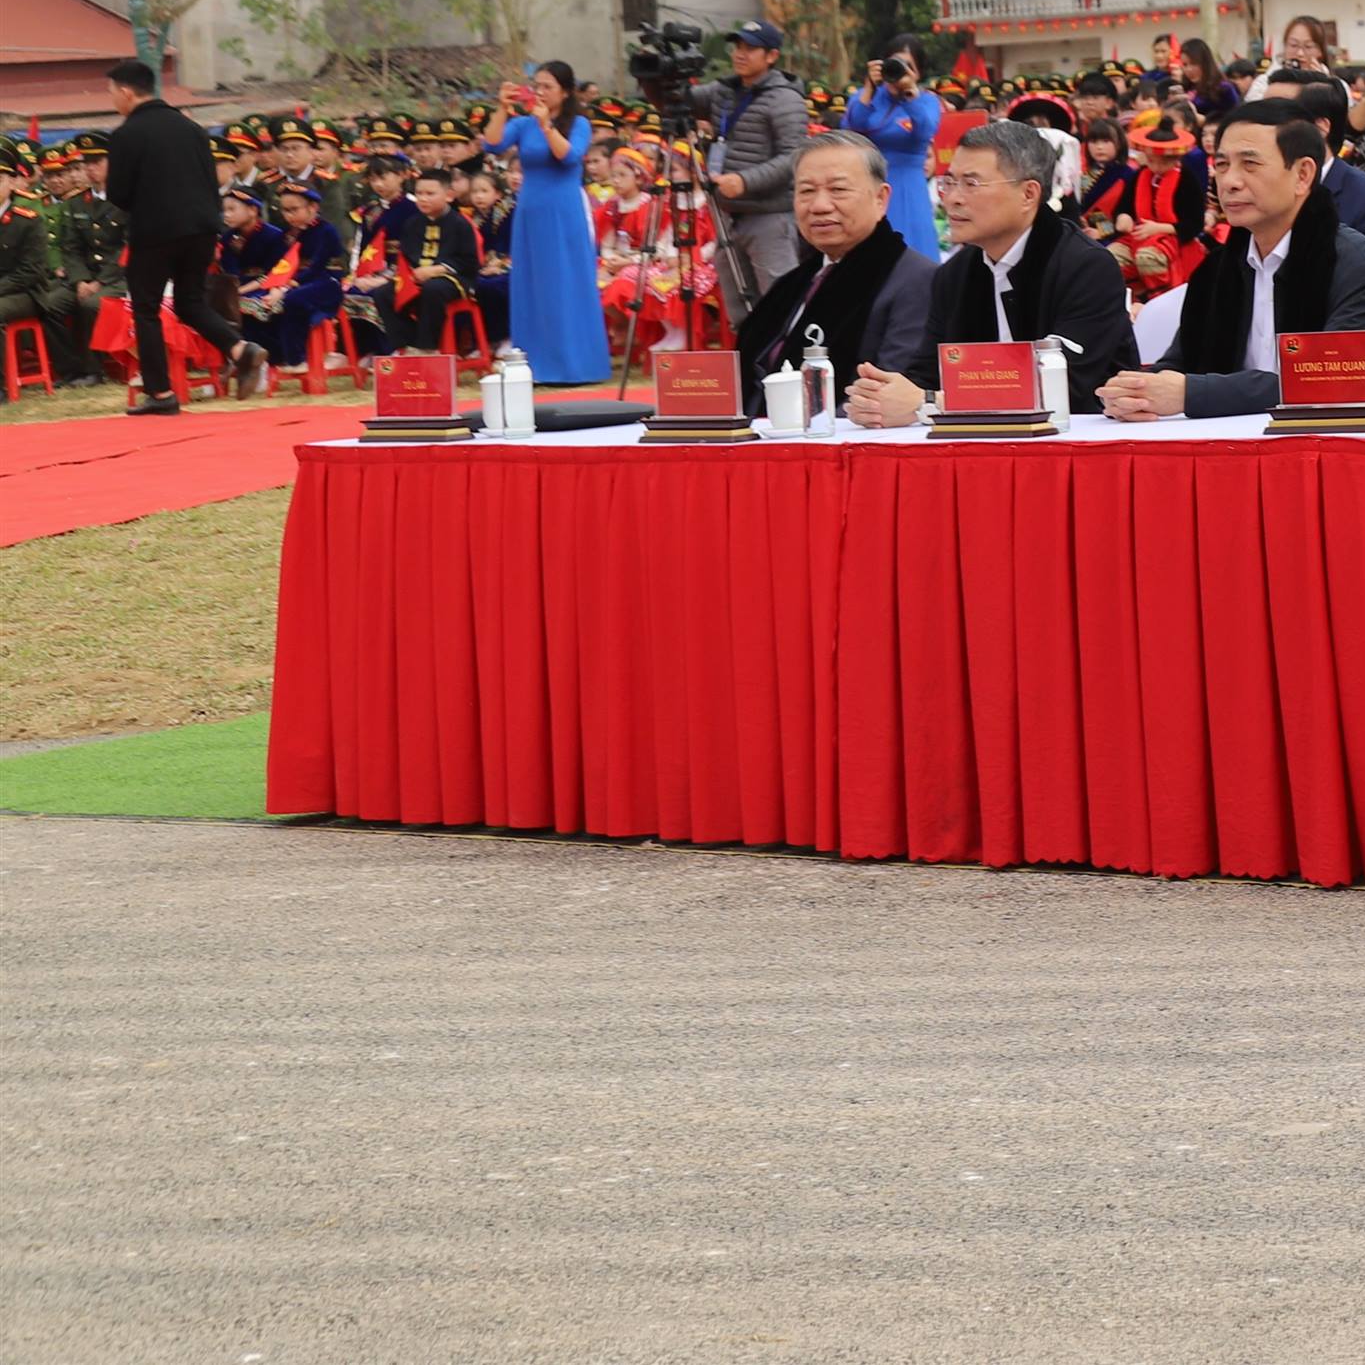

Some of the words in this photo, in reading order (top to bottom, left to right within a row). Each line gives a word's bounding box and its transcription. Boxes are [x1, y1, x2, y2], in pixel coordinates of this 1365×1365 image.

[1293, 361, 1323, 373] LƯƠNG
[1324, 361, 1341, 372] TAM
[959, 370, 979, 380] PHAN
[980, 368, 995, 380] VĂN
[996, 370, 1020, 380] GIANG
